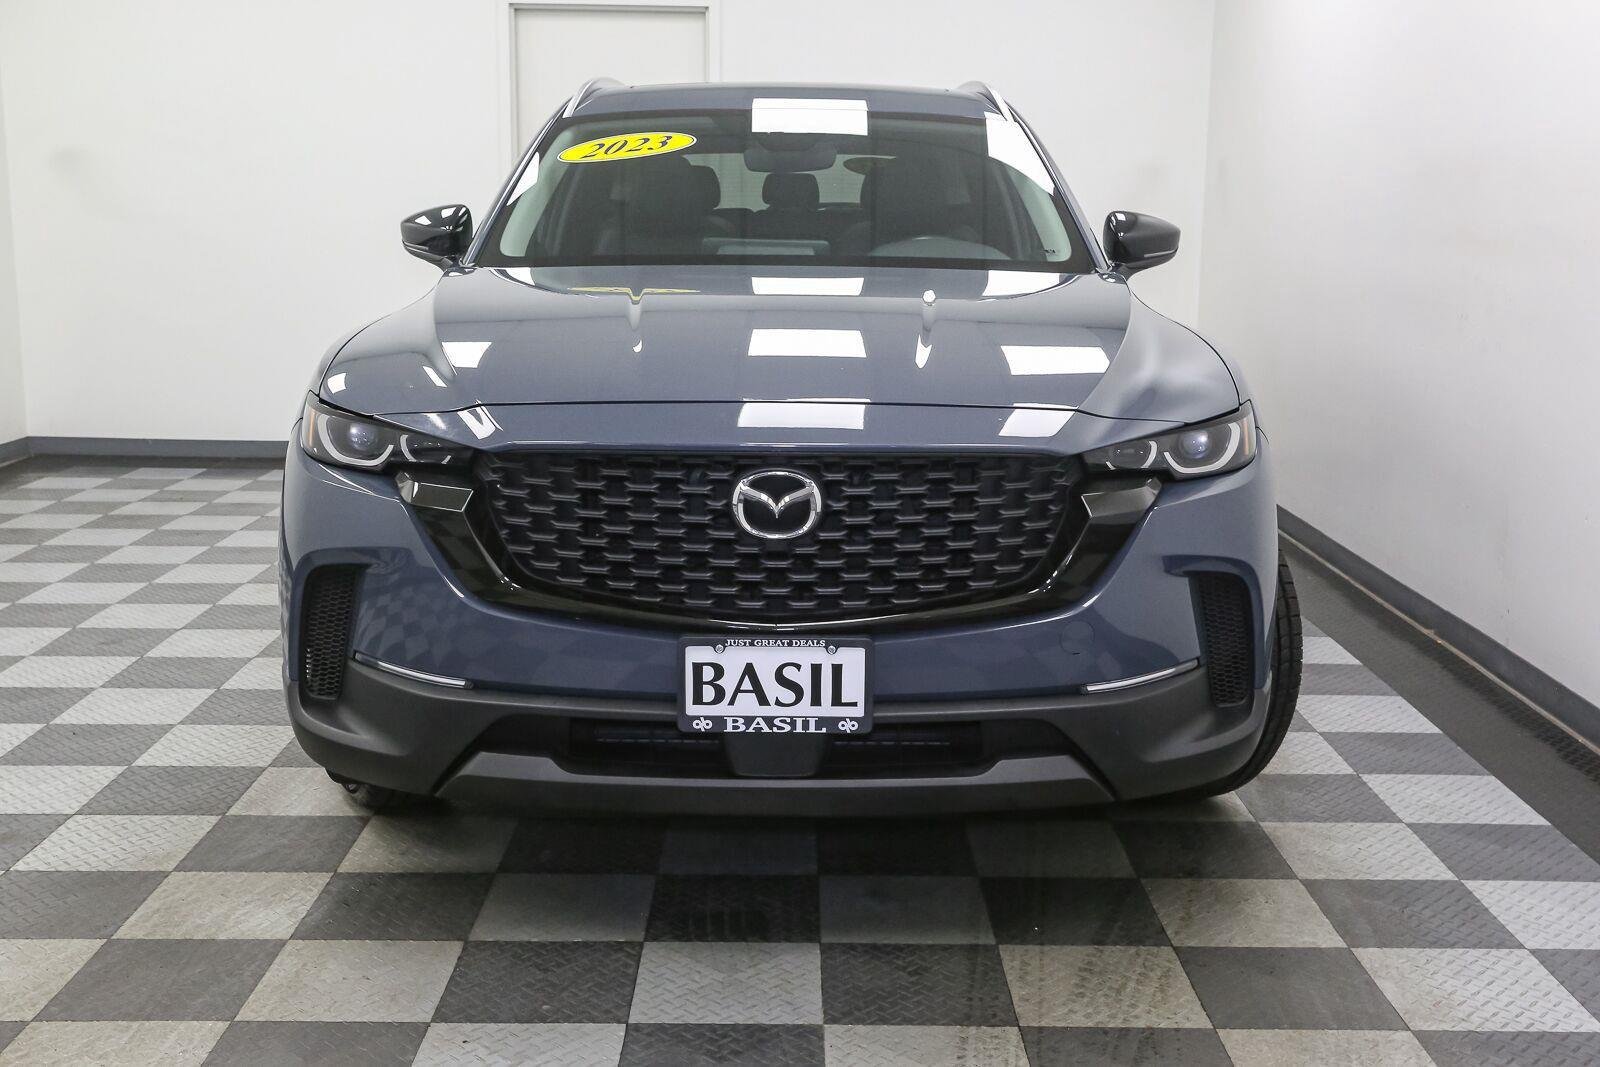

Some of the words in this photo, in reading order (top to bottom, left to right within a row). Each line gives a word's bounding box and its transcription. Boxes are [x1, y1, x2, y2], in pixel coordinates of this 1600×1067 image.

[579, 135, 673, 159] 2023
[725, 639, 751, 647] JUST
[754, 639, 789, 647] GREAT
[792, 639, 826, 647] DEALS
[691, 661, 858, 708] BASIL
[723, 716, 827, 733] BASIL
